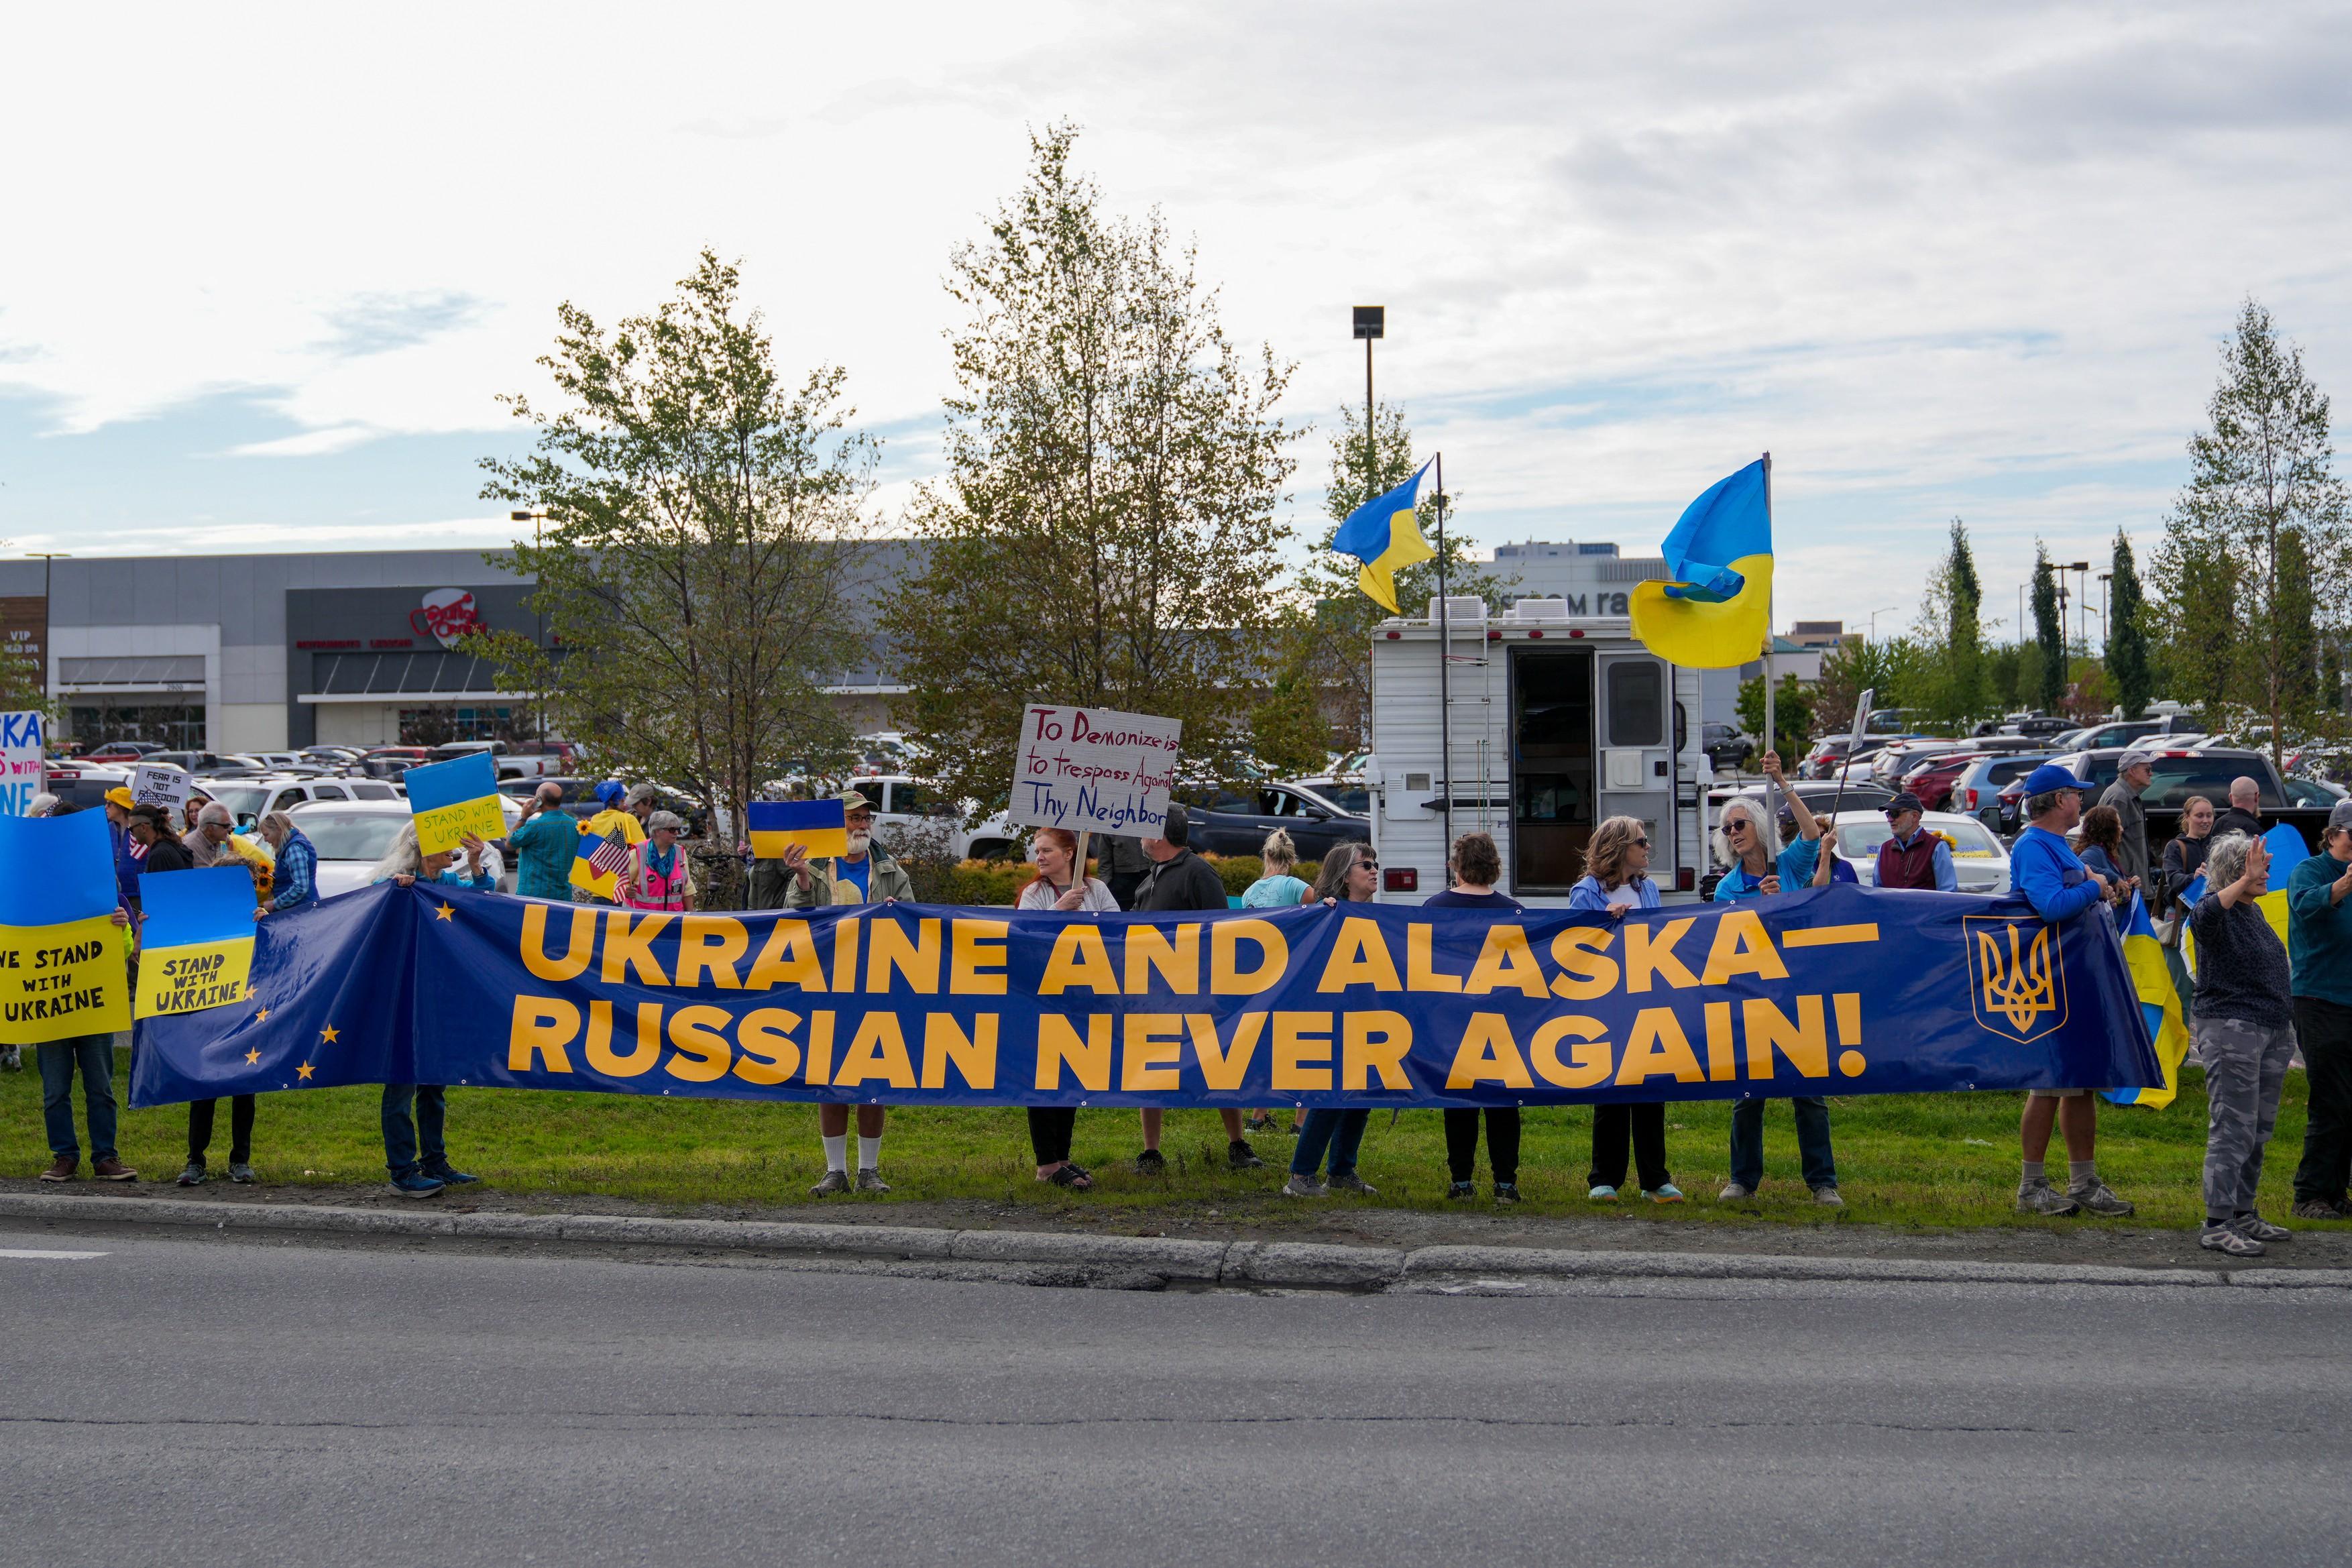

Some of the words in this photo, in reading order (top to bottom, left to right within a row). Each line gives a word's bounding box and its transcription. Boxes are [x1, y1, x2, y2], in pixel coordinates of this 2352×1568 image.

[1598, 592, 1630, 615] ra
[10, 630, 31, 641] VIP
[24, 643, 40, 654] SPA
[0, 714, 41, 748] KA
[1029, 708, 1062, 741] To
[1071, 711, 1162, 747] Demonize
[1164, 734, 1180, 751] is
[11, 761, 41, 775] WITH
[147, 771, 170, 782] FEAR
[172, 775, 182, 784] IS
[1025, 744, 1048, 775] to
[1052, 748, 1130, 788] trespass
[1132, 755, 1174, 795] Against
[138, 789, 180, 804] FEDOM
[152, 782, 170, 792] NOT
[423, 809, 467, 830] STAND
[471, 801, 500, 818] WITH
[1021, 781, 1068, 826] Thy
[1076, 785, 1167, 829] Neighbor
[434, 820, 496, 843] UKRAINE
[34, 940, 103, 969] STAND
[520, 904, 1009, 995] UKRAINE
[1037, 919, 1288, 995] AND
[162, 954, 225, 976] STAND
[22, 973, 71, 993] WITH
[174, 970, 218, 989] WITH
[5, 987, 105, 1022] UKRAINE
[156, 981, 240, 1011] UKRAINE
[508, 994, 999, 1088] RUSSIAN
[1035, 1009, 1413, 1090] NEVER
[1445, 993, 1866, 1088] AGAIN!
